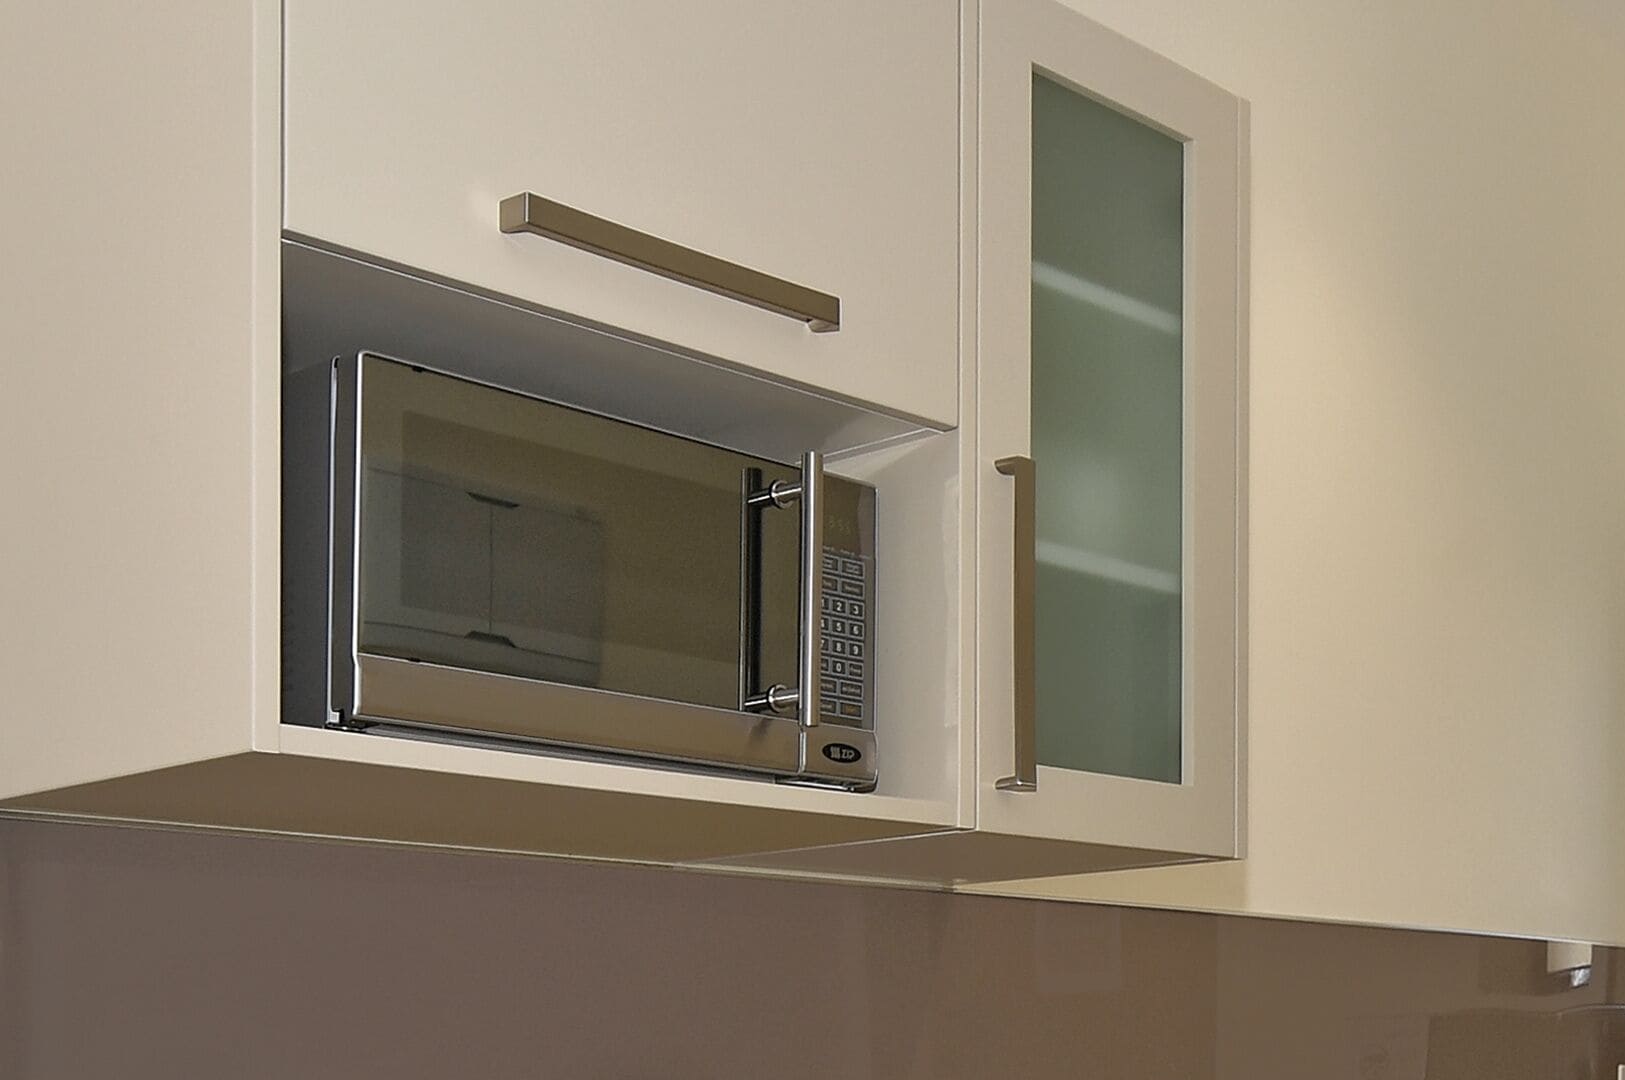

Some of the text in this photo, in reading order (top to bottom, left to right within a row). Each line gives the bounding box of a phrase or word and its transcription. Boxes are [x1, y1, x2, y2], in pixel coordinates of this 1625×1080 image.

[836, 602, 842, 611] 2
[853, 605, 859, 615] 3
[836, 622, 842, 632] 5
[853, 625, 859, 635] 6
[836, 642, 842, 652] 8
[853, 645, 859, 655] 9
[836, 662, 842, 672] 0
